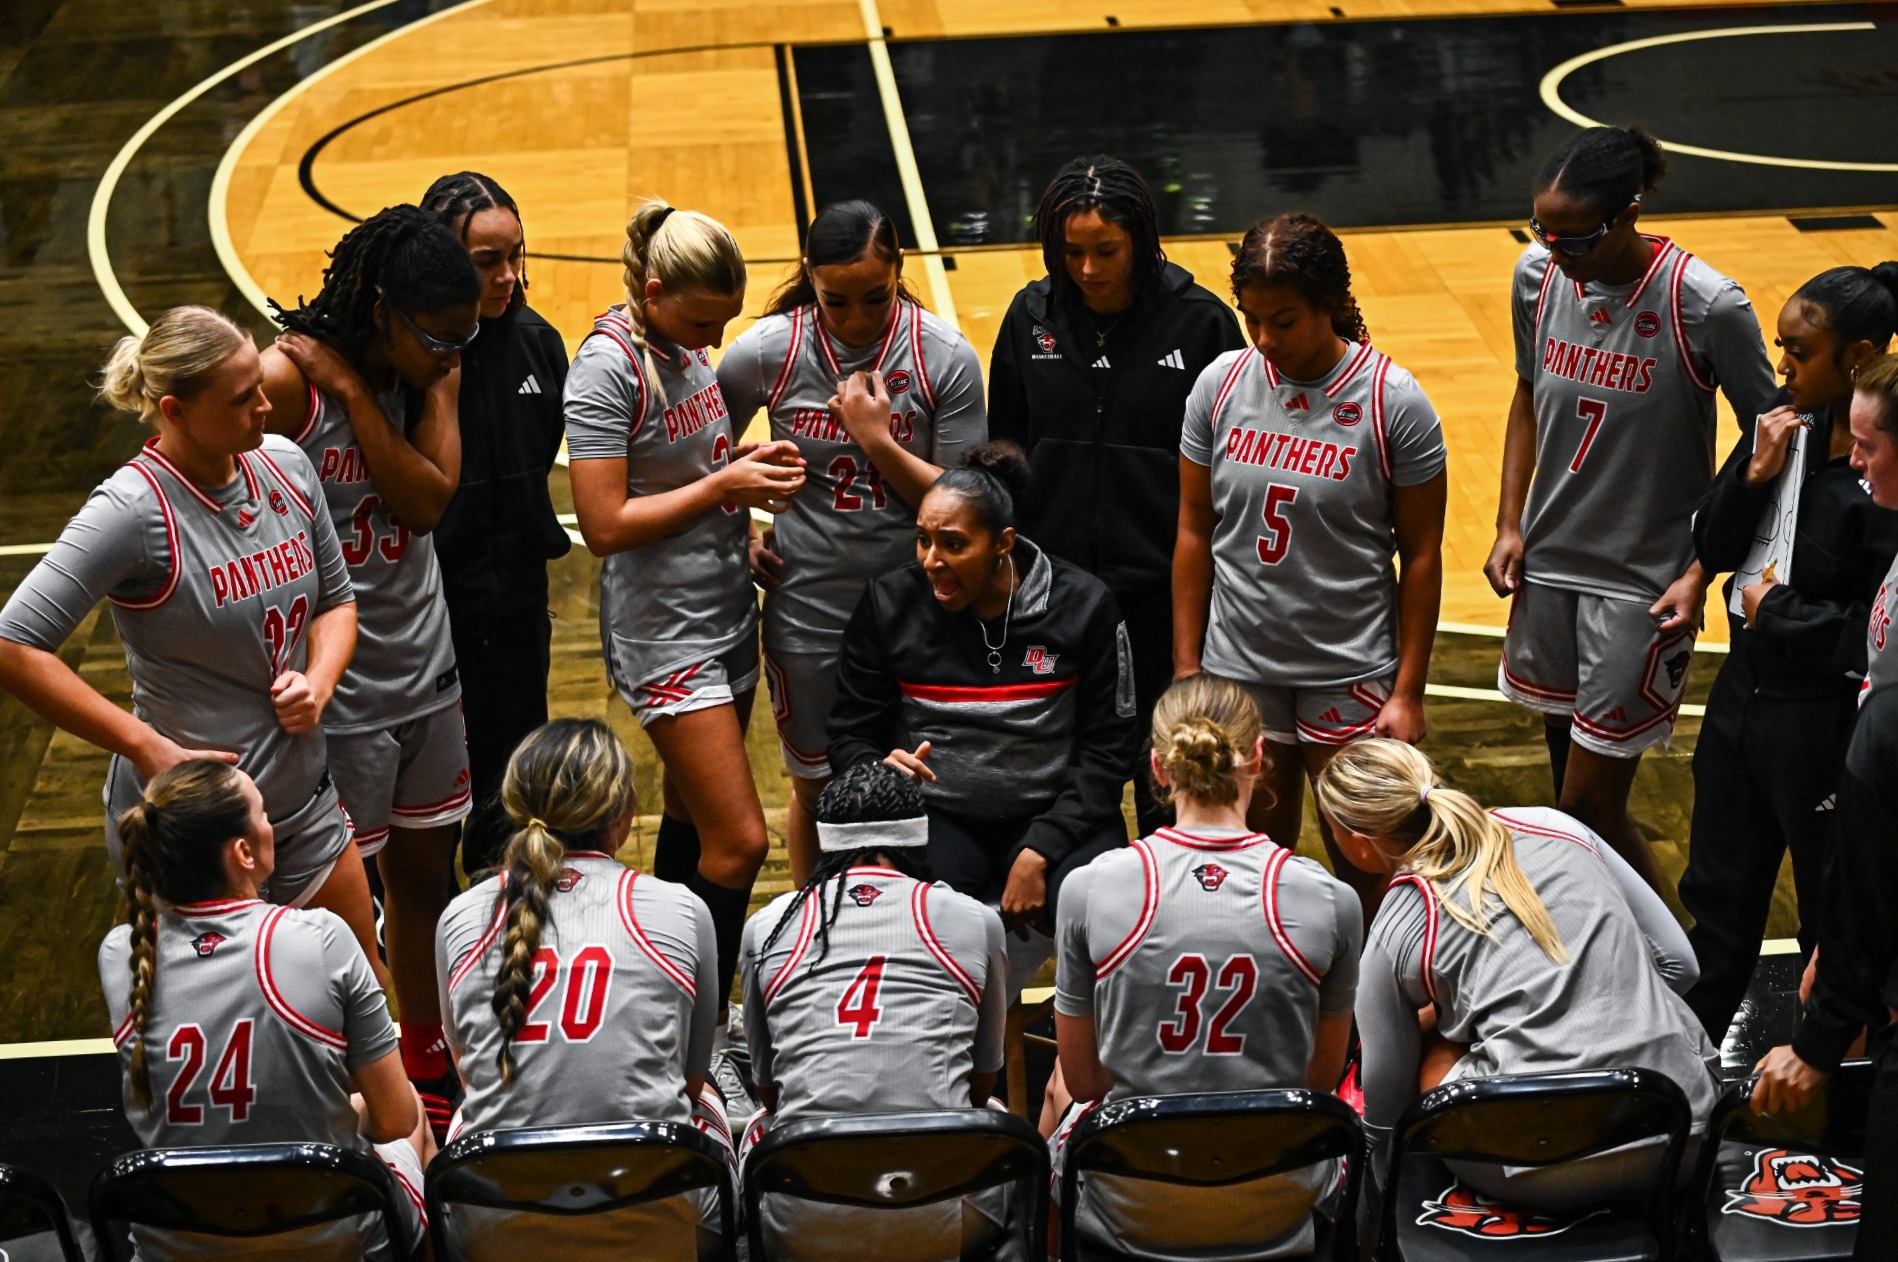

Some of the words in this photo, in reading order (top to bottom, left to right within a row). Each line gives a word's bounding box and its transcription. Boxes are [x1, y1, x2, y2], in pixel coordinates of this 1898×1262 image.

[1542, 337, 1658, 394] PANTHERS
[664, 380, 728, 444] PANTHE
[792, 407, 917, 443] PANRS
[1568, 395, 1608, 474] 7
[826, 455, 888, 512] 21
[1225, 426, 1358, 482] PANTHERS
[342, 493, 412, 567] 33
[1256, 482, 1300, 566] 5
[209, 530, 315, 609] PANTHERS
[263, 592, 309, 681] 22
[1021, 645, 1060, 675] DU
[510, 943, 616, 1045] 20
[834, 953, 889, 1041] 4
[1156, 952, 1260, 1056] 32
[165, 1017, 257, 1126] 24
